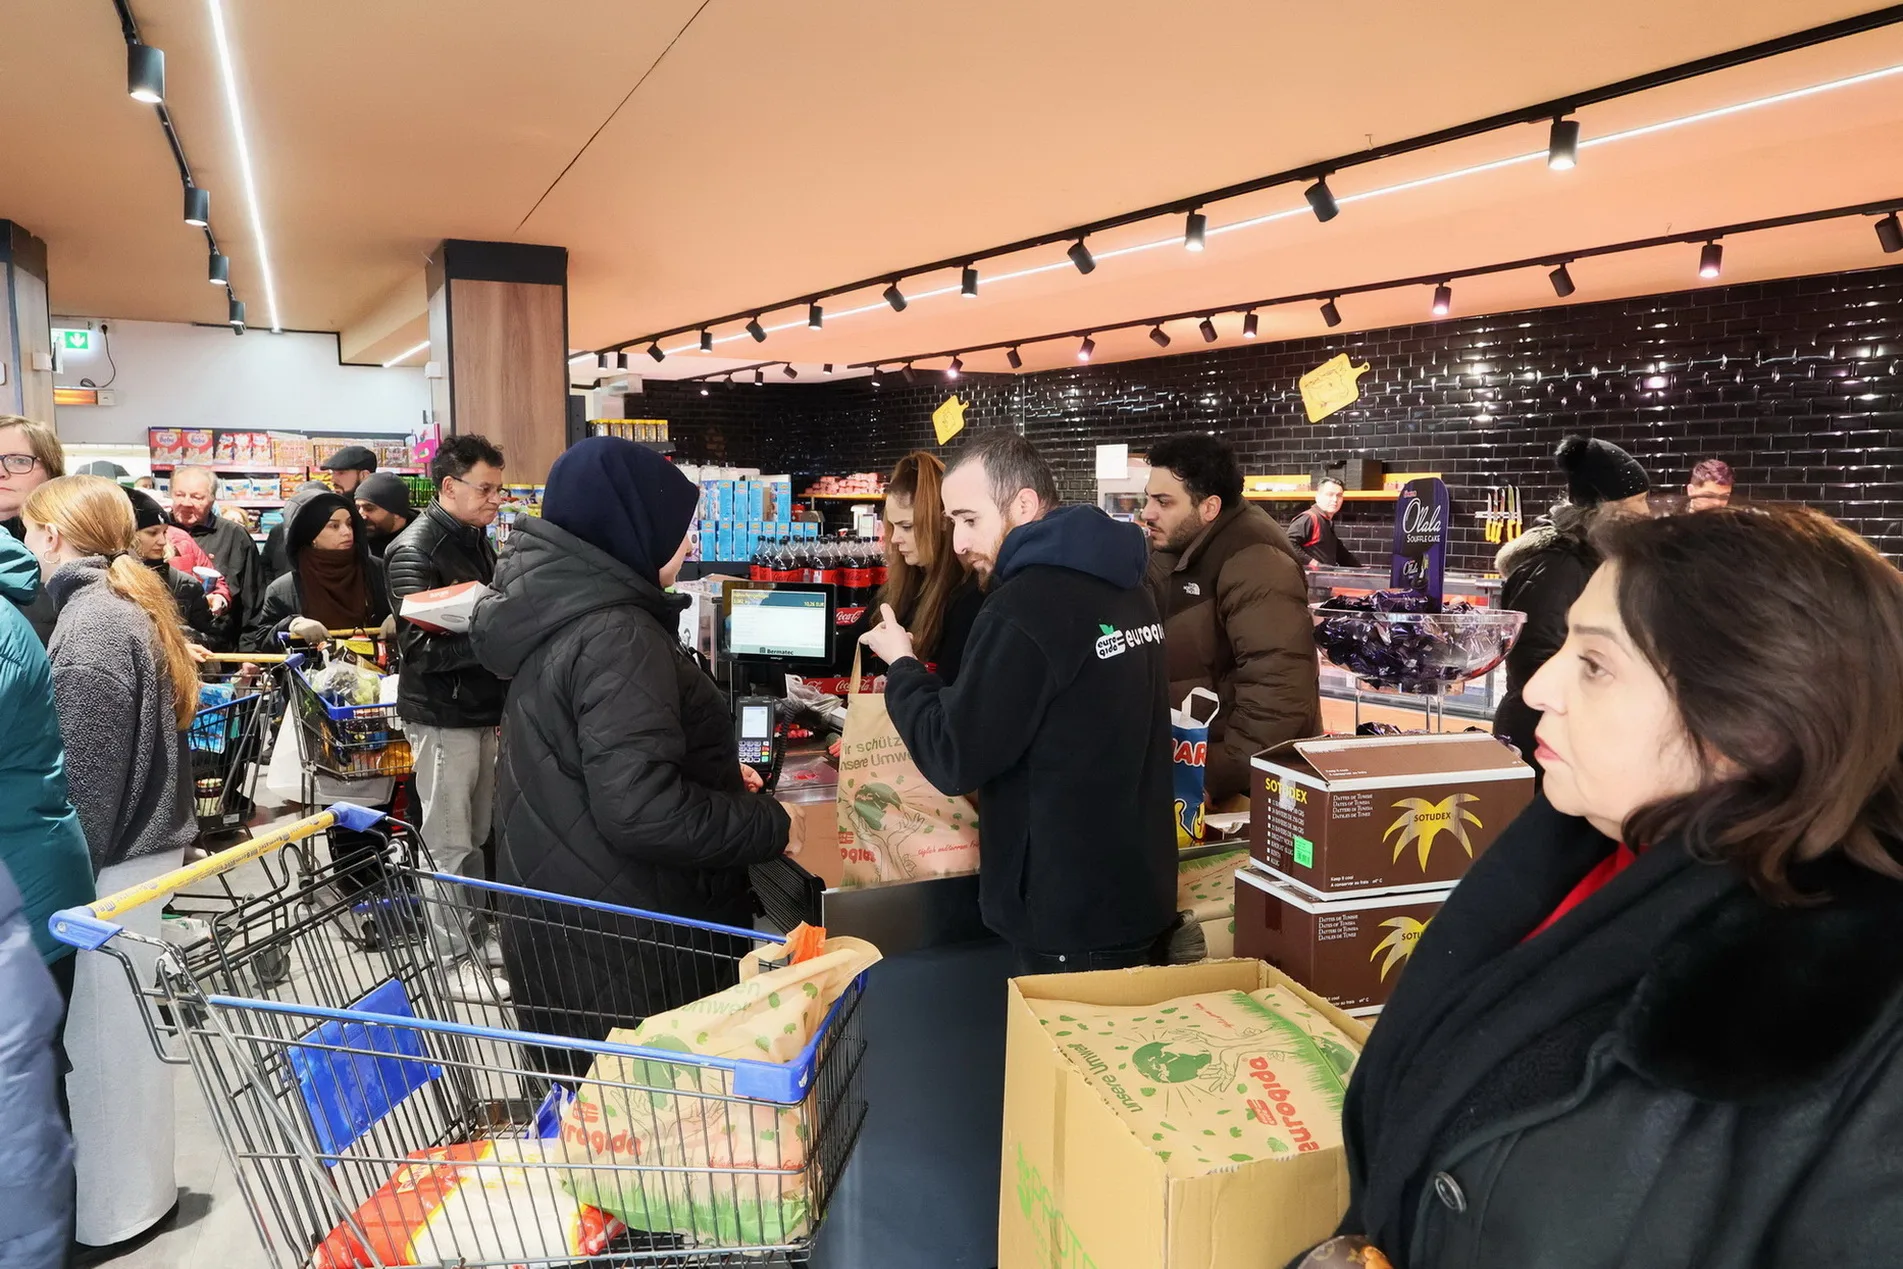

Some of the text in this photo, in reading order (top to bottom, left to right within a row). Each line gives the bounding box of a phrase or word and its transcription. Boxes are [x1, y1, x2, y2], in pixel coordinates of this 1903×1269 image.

[766, 648, 794, 656] Bermatec
[1172, 738, 1207, 767] AR
[1414, 812, 1451, 822] SOTUDEX
[1102, 1074, 1144, 1112] unsere
